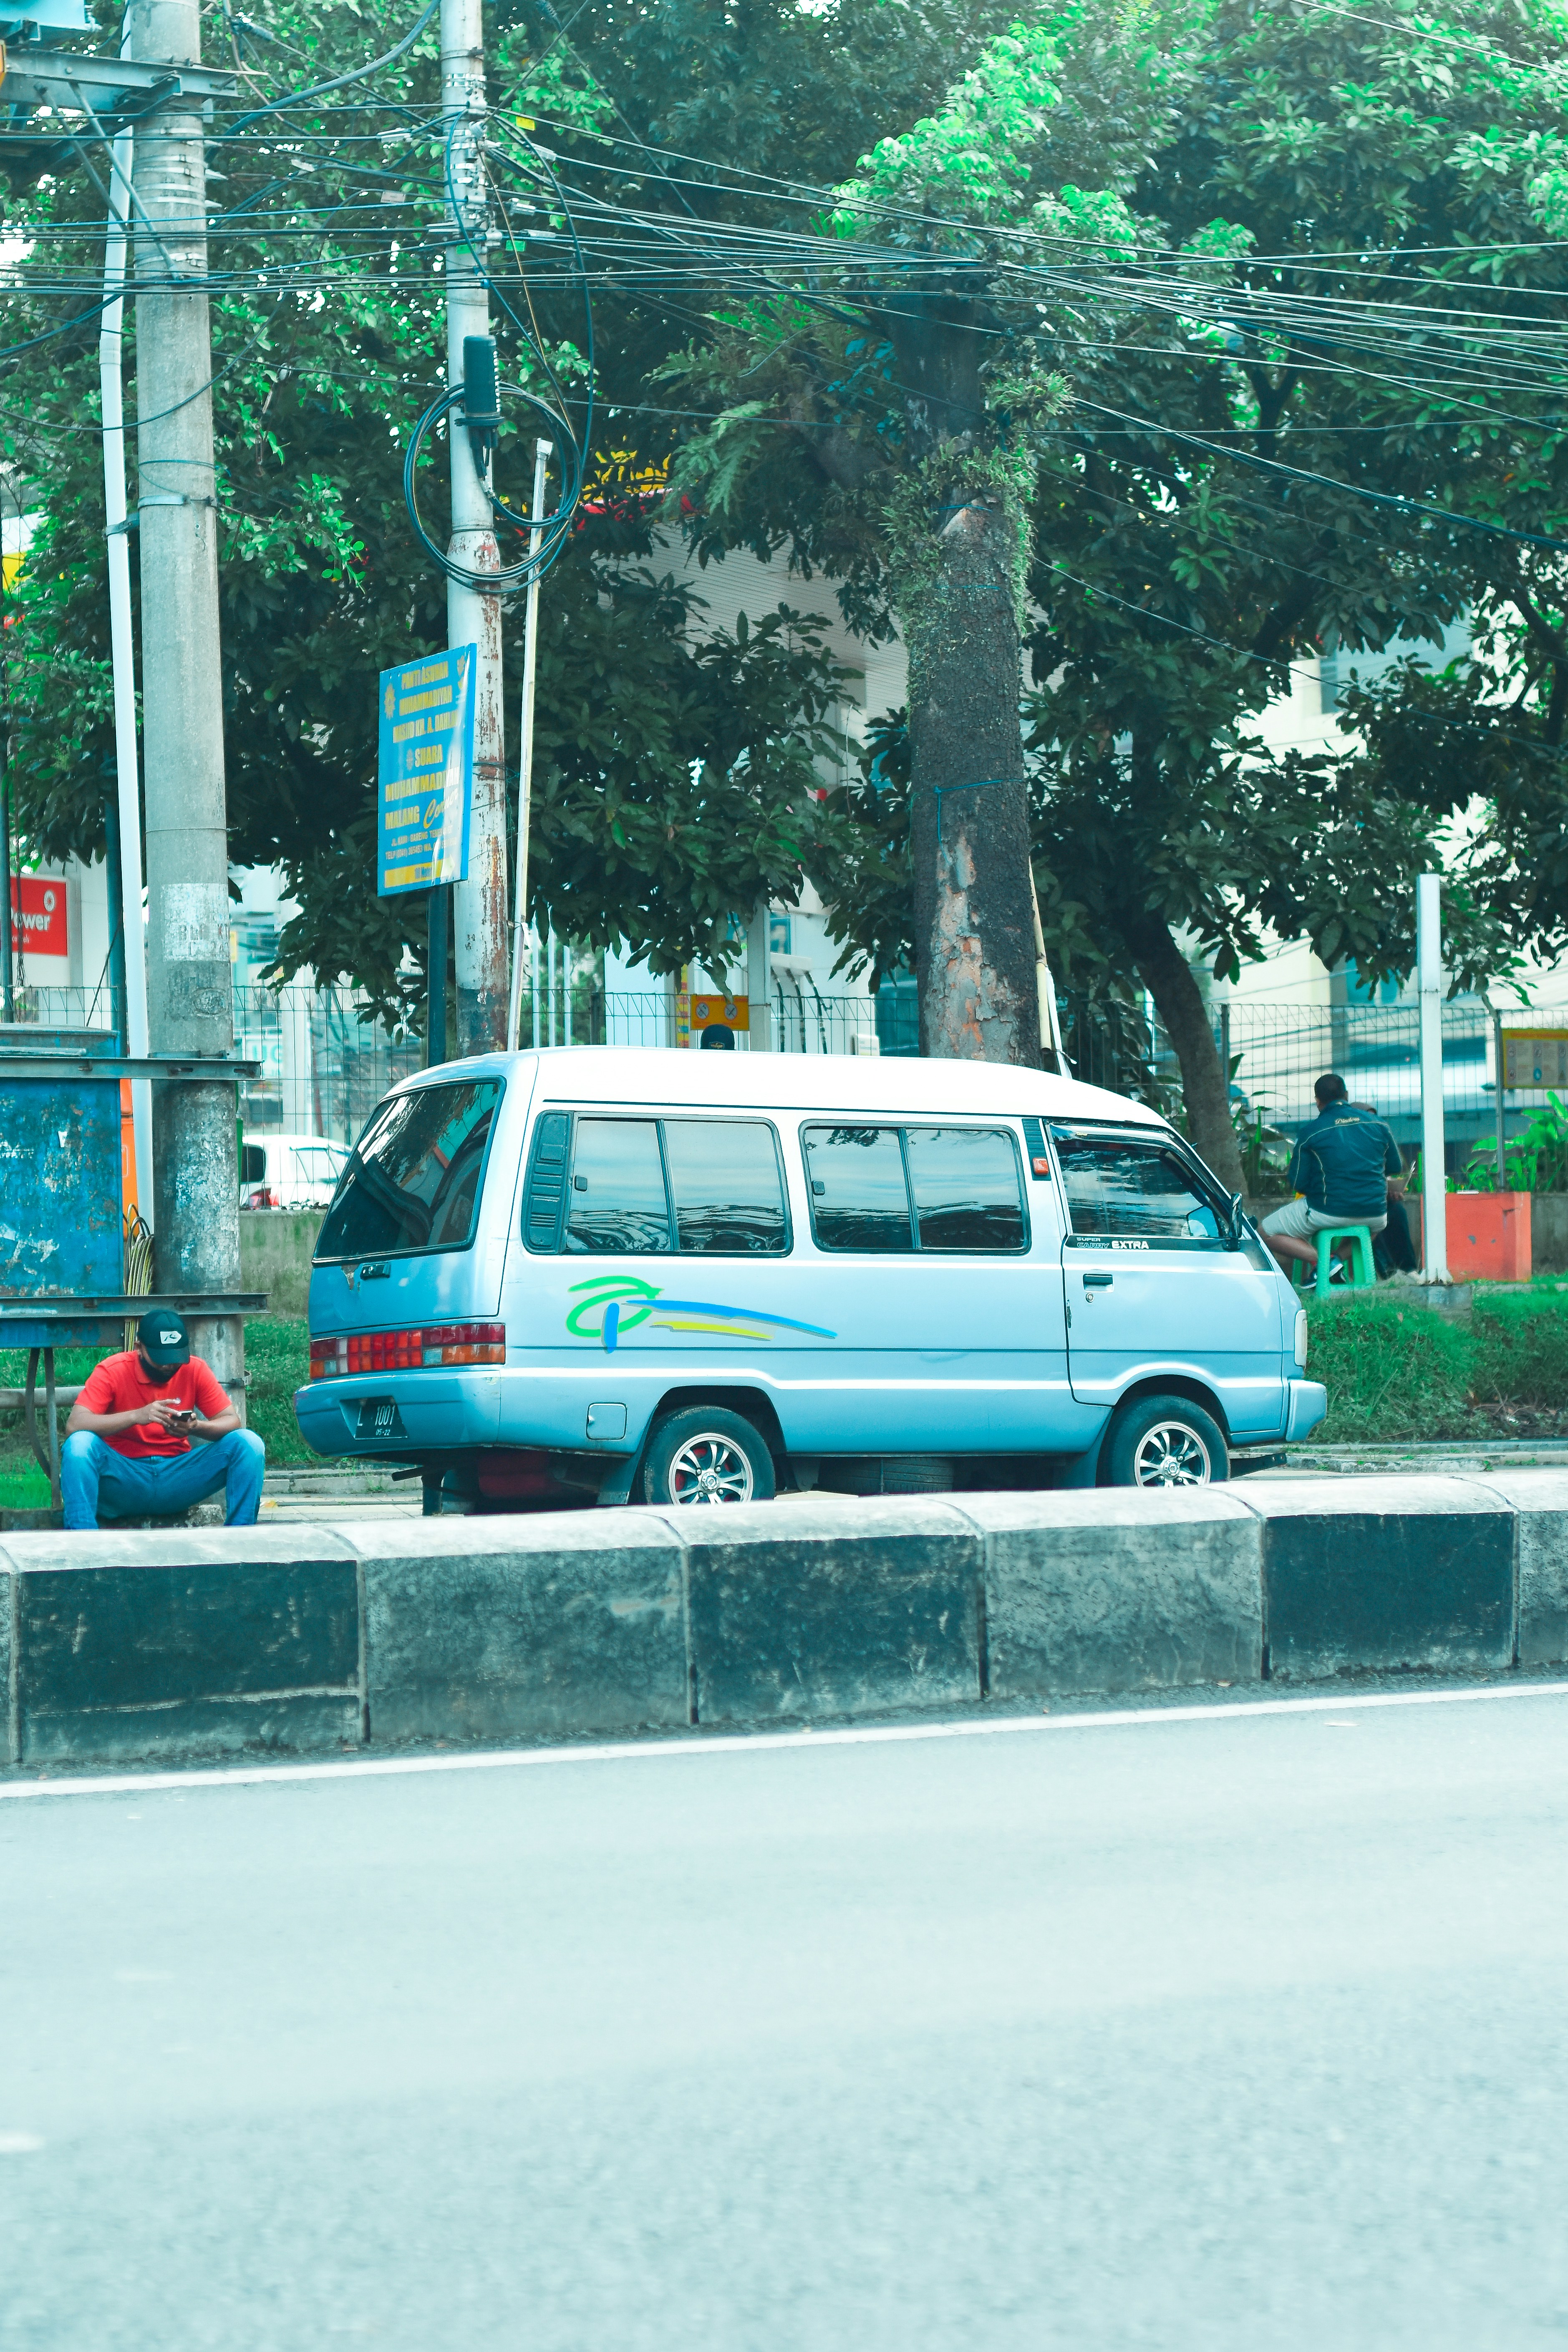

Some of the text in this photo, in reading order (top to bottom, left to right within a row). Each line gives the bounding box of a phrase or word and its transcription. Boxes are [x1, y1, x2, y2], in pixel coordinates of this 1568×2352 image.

[421, 661, 449, 685] ASUHAN
[399, 685, 453, 716] MUHAMMADIYAH
[414, 744, 443, 768] SUARA
[385, 766, 459, 802] MUHAMMADIYAH
[385, 787, 459, 830] MALANG Corner
[1111, 1240, 1150, 1249] EXTRA
